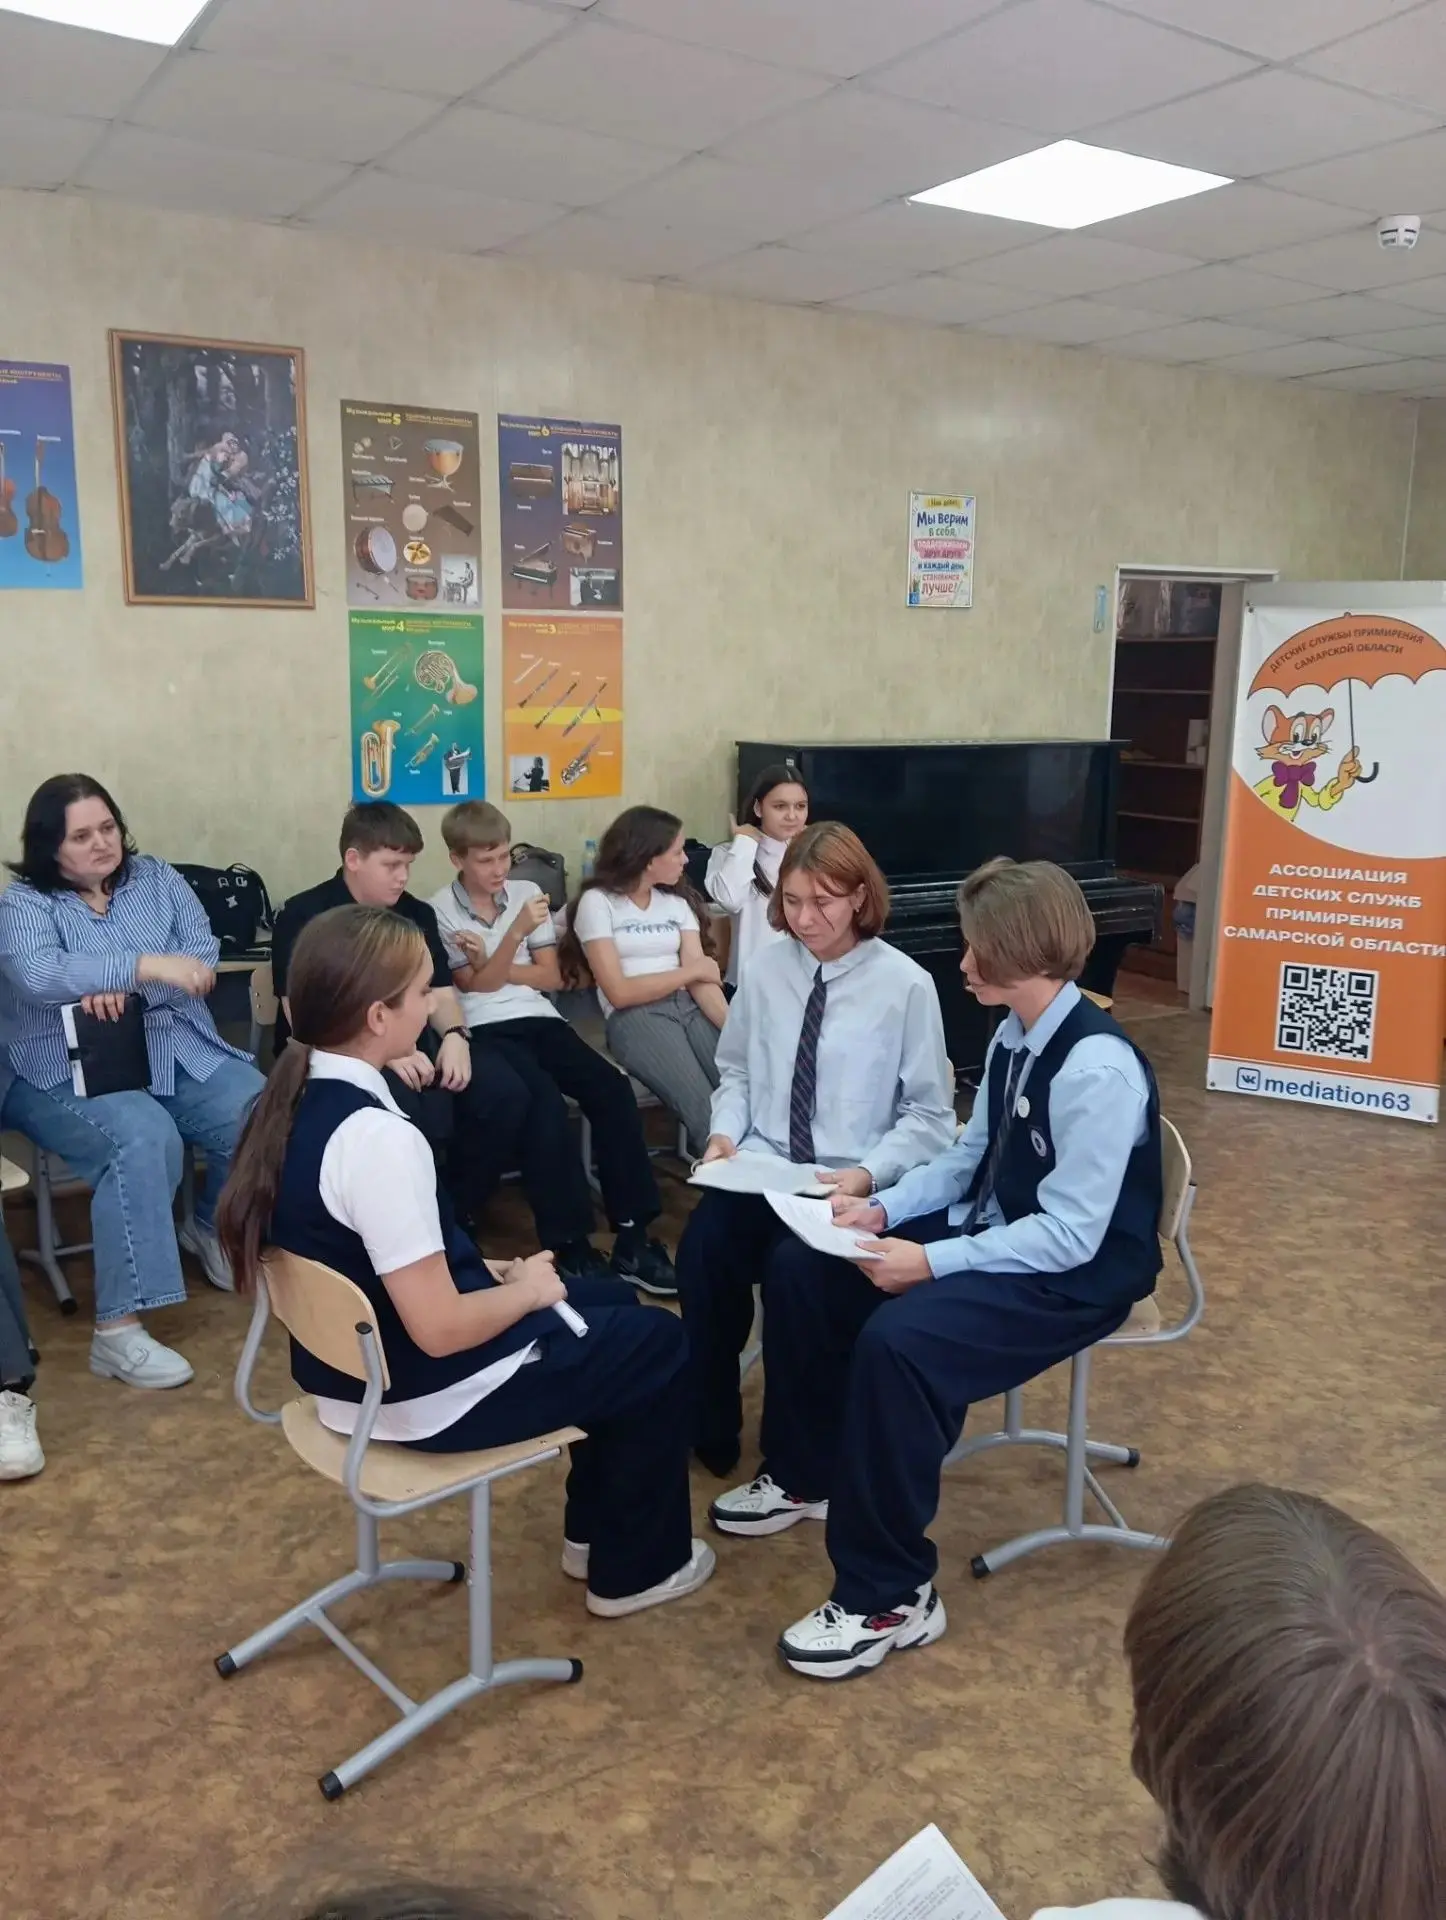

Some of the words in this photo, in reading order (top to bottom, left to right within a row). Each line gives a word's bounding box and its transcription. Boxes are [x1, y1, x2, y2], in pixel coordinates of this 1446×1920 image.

[541, 425, 550, 436] 6
[917, 511, 936, 527] Мы
[938, 513, 969, 527] верим
[396, 620, 404, 632] 4
[1269, 642, 1307, 673] ДЕТСКИЕ
[1309, 628, 1351, 648] СЛУЖБЫ
[1353, 627, 1425, 645] ПРИМИРЕНИЯ
[1294, 642, 1354, 671] САМАРСКОЙ
[1356, 642, 1404, 655] ОБЛАСТИ
[1268, 863, 1408, 884] АССОЦИАЦИЯ
[1252, 884, 1342, 903] ДЕТСКИХ
[1347, 890, 1422, 909] СЛУЖБ
[1265, 907, 1403, 930] ПРИМИРЕНИЯ
[1224, 925, 1345, 948] САМАРСКОЙ
[1350, 937, 1446, 957] ОБЛАСТИ
[1265, 1076, 1411, 1112] mediation63
